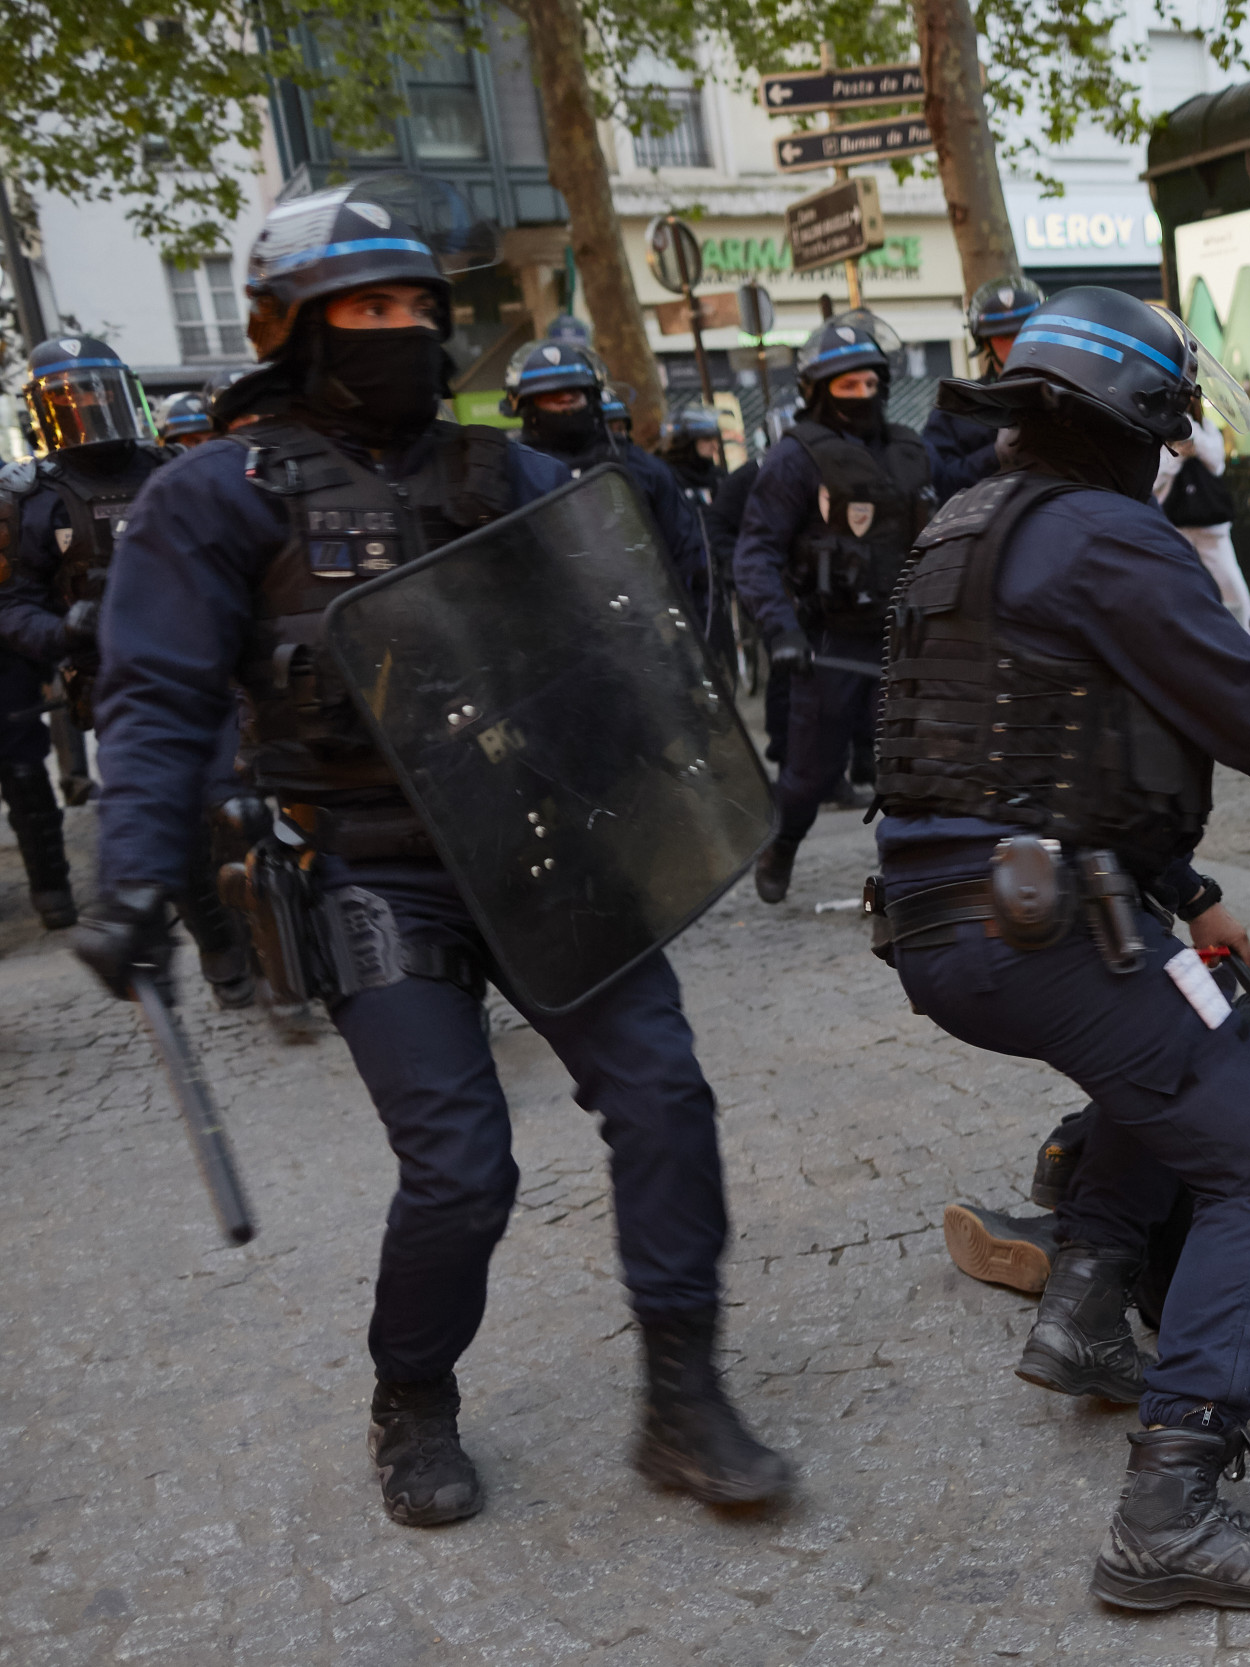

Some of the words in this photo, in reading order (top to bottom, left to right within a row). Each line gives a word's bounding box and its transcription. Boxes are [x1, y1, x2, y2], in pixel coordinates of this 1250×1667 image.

[833, 80, 875, 97] Poste
[880, 76, 898, 92] de
[1025, 213, 1134, 248] LEROY
[307, 511, 397, 531] POLICE
